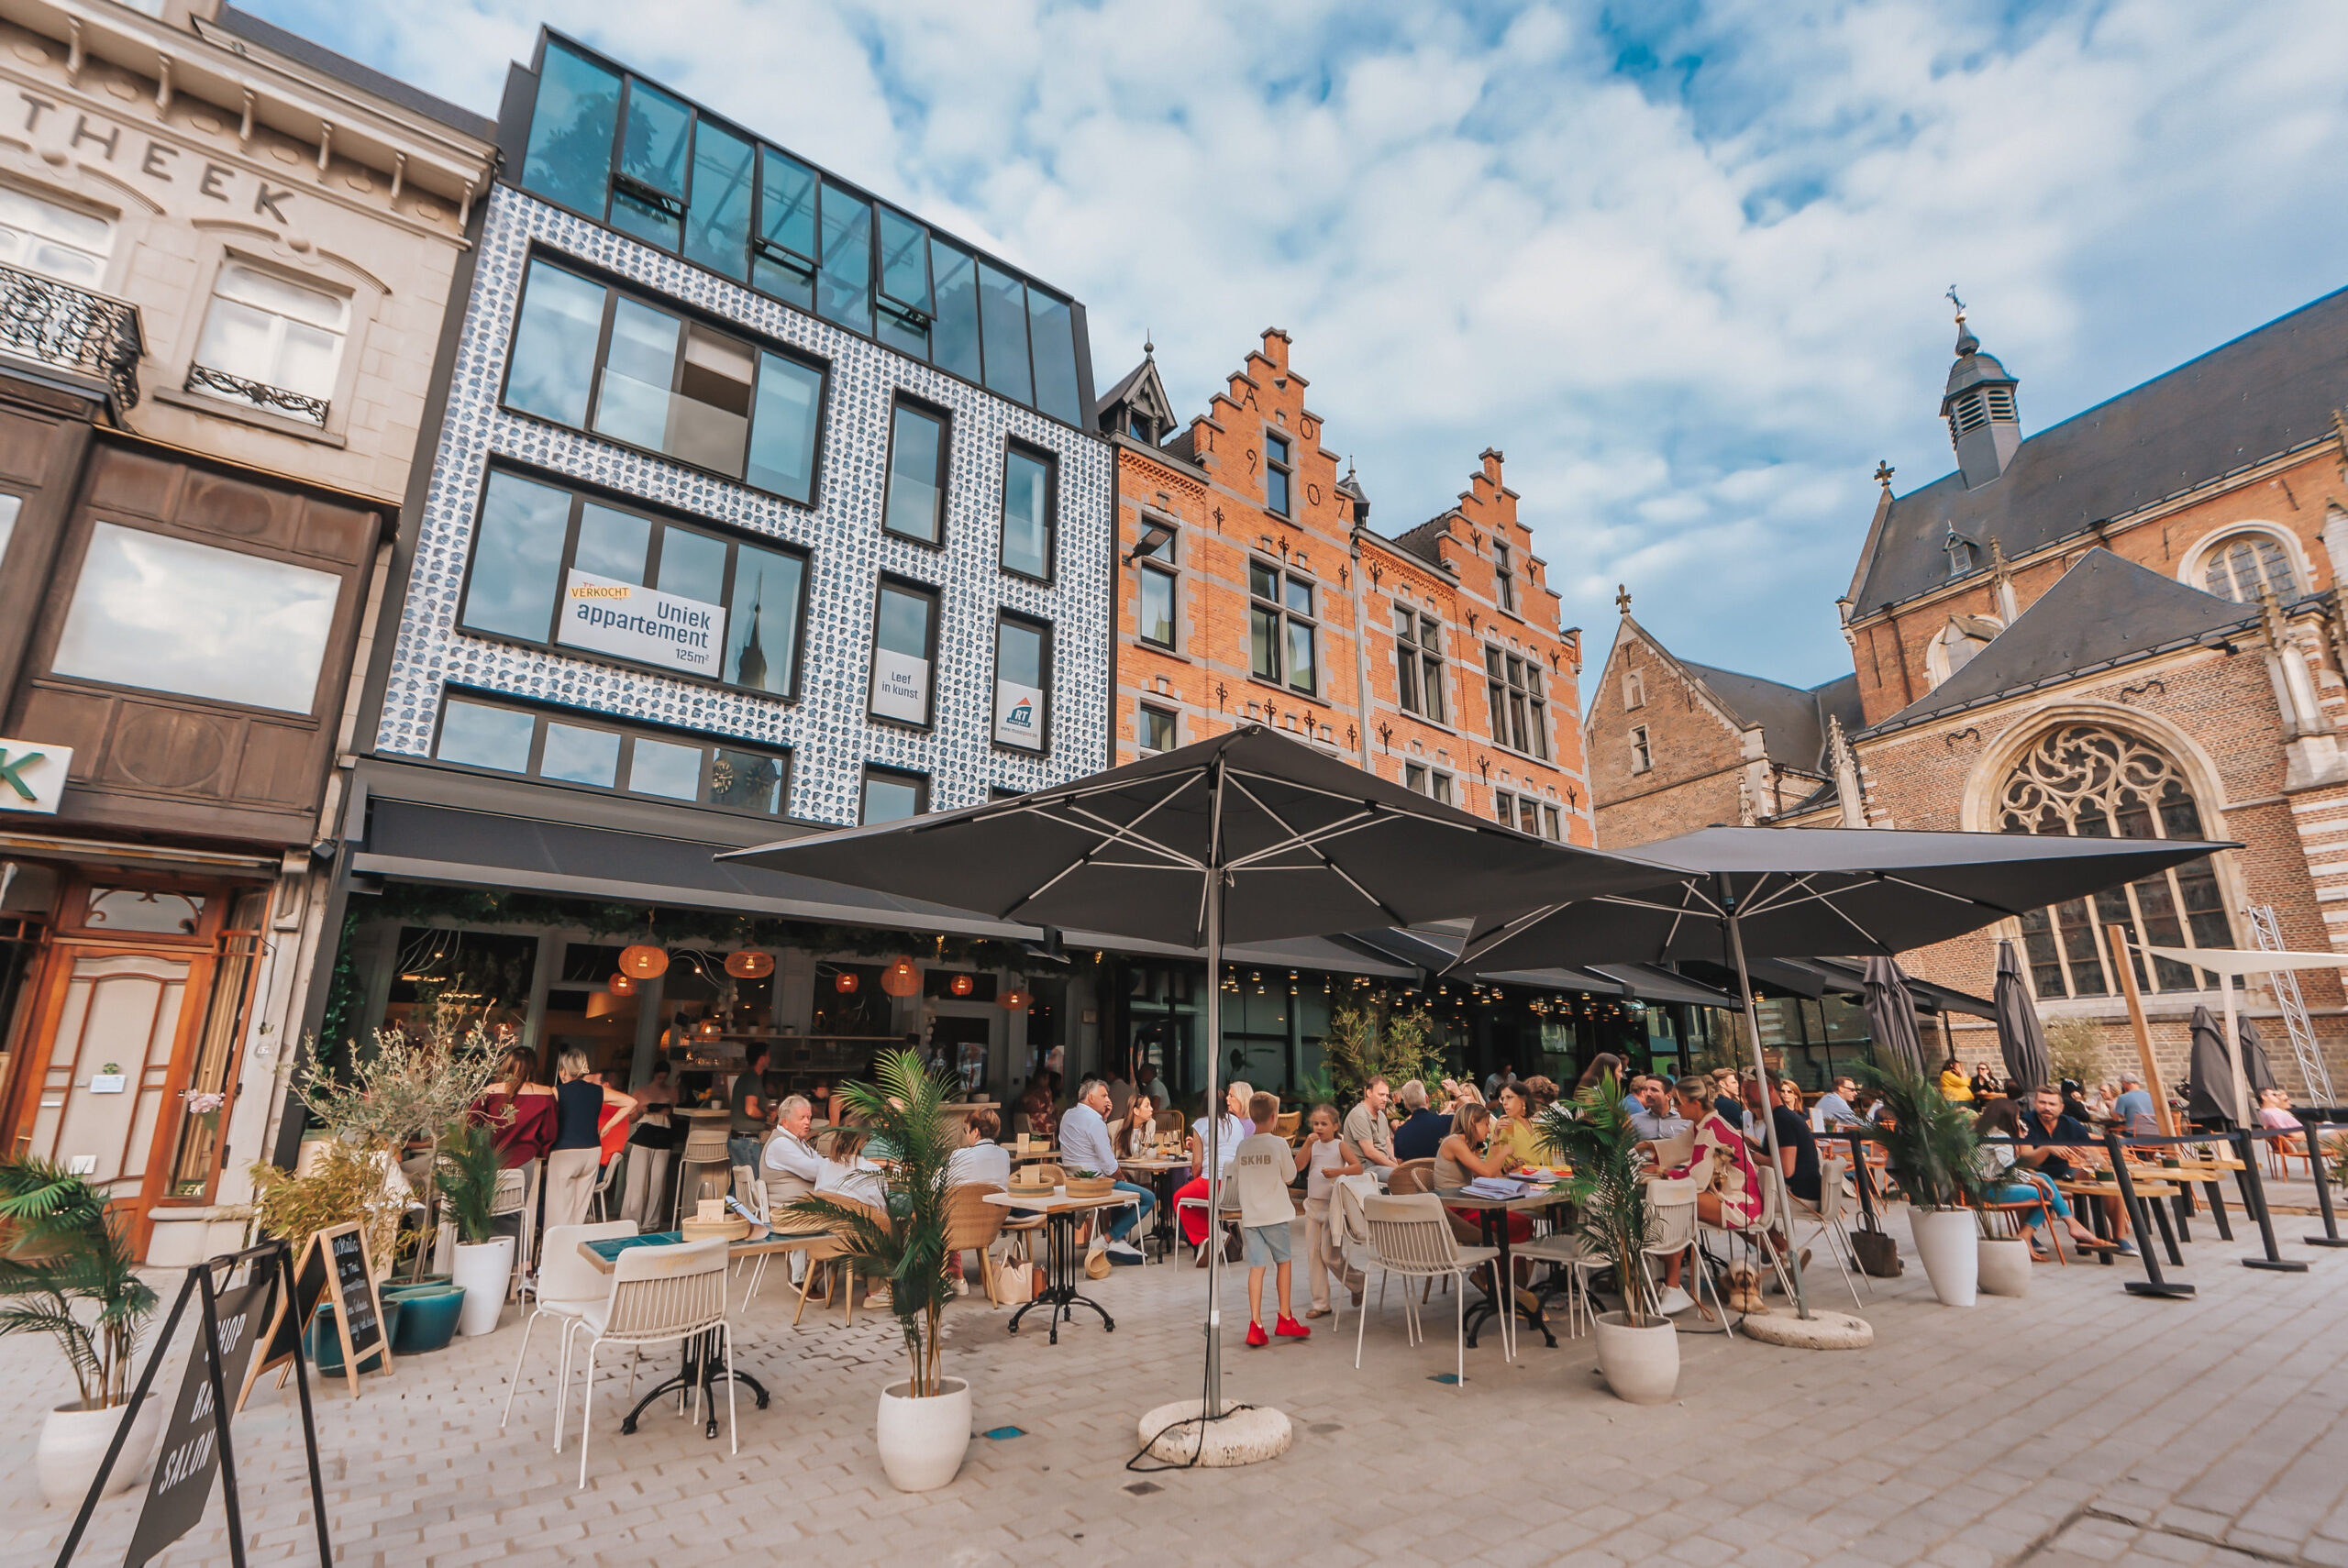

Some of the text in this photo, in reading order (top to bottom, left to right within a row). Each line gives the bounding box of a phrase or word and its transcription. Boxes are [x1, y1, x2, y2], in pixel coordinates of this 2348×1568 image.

[19, 92, 294, 226] THEEK
[571, 587, 629, 598] VERKOCHT
[577, 603, 709, 649] appartement
[657, 601, 711, 630] Uniek
[881, 680, 919, 700] in kunst
[892, 671, 911, 685] Leef
[1240, 1154, 1271, 1165] SKHB
[205, 1313, 247, 1363] HOP
[190, 1372, 227, 1423] BA
[158, 1427, 216, 1496] SALON
